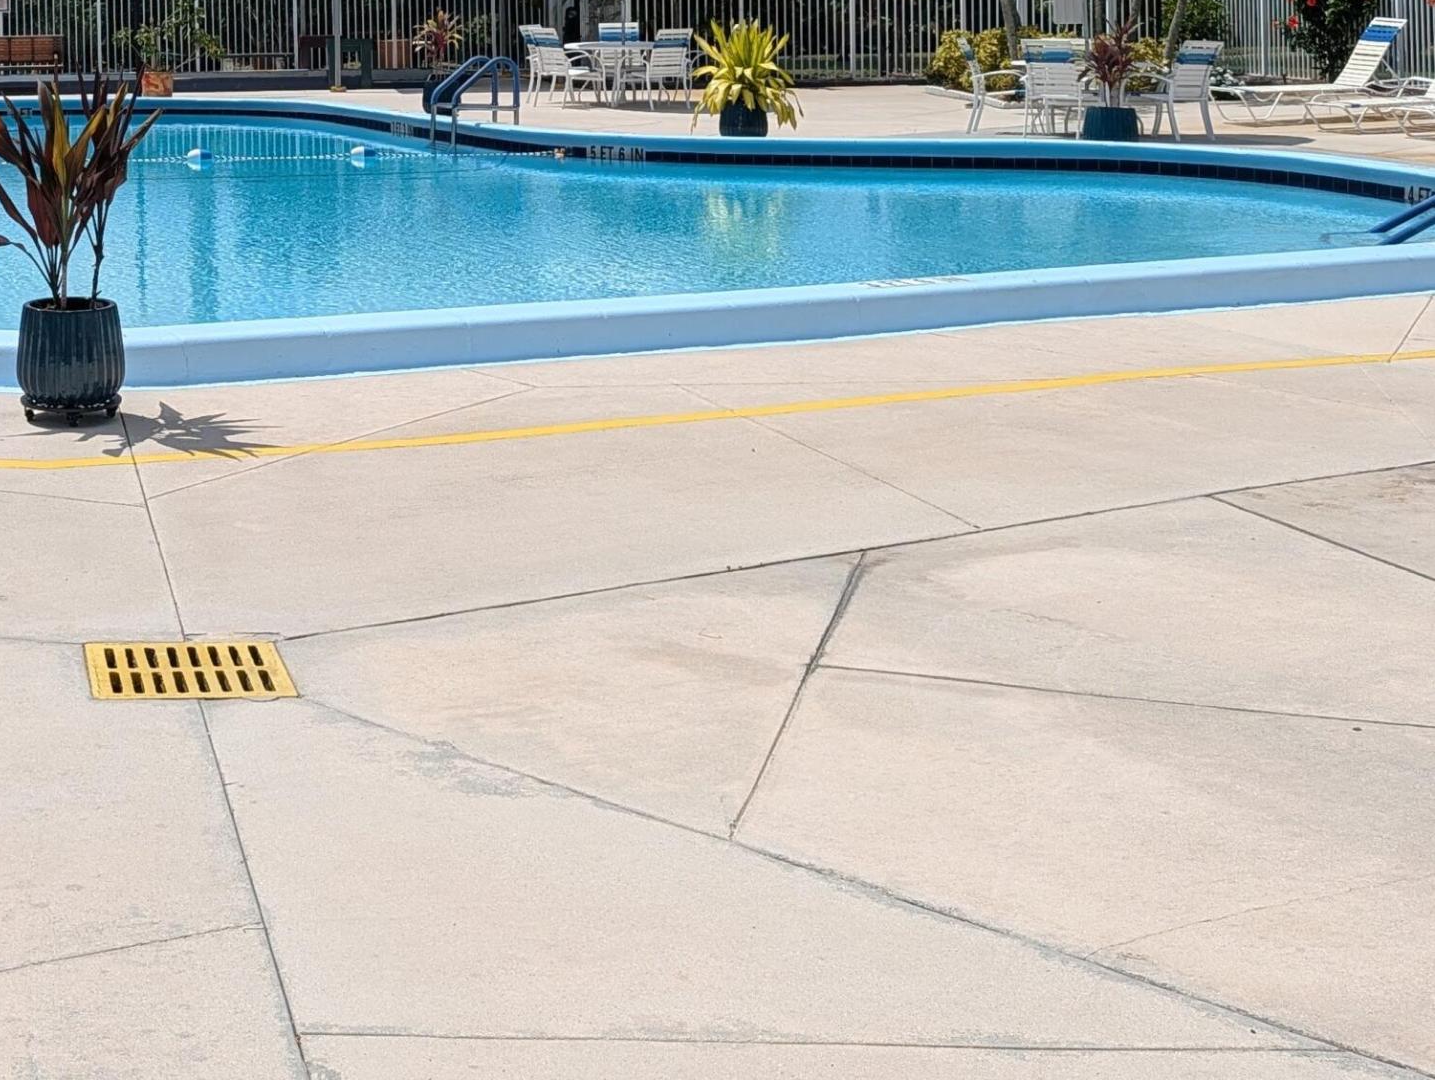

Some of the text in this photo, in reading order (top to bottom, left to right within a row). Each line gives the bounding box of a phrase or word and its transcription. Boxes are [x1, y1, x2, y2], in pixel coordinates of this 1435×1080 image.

[591, 145, 644, 161] 5 FT 6 IN
[1408, 185, 1415, 204] 4
